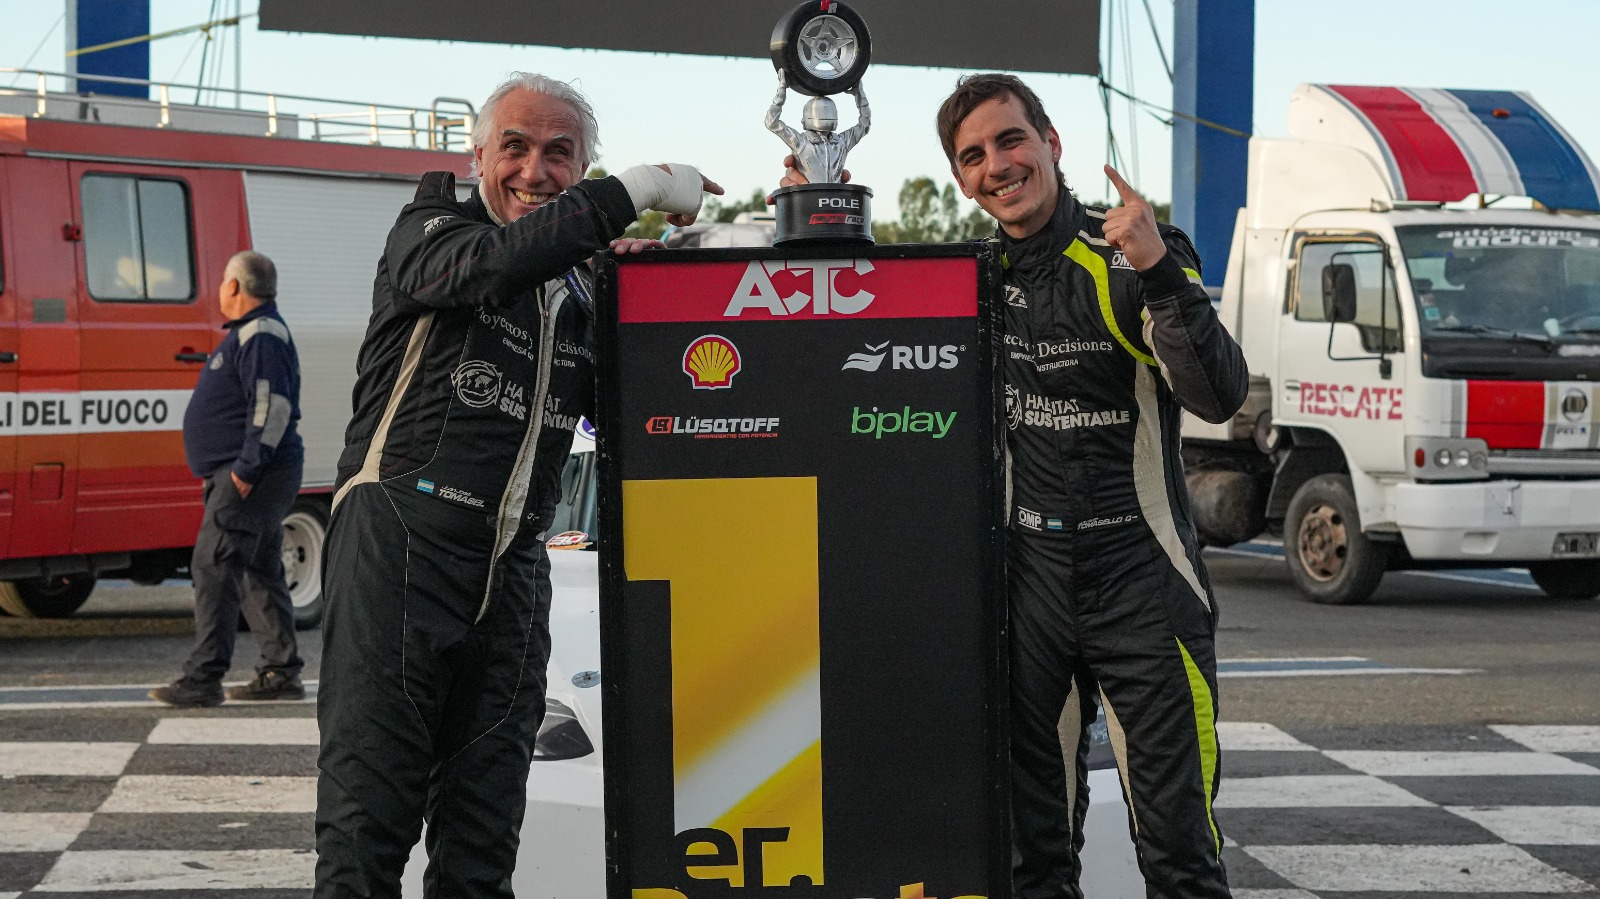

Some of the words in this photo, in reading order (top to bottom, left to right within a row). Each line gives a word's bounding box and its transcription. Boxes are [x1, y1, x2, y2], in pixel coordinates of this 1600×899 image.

[818, 198, 860, 209] POLE
[1111, 253, 1134, 268] OM
[723, 259, 876, 316] ACTC
[1037, 338, 1113, 358] Decisiones
[1299, 382, 1403, 420] RESCATE
[22, 400, 72, 426] DEL
[81, 398, 168, 425] FUOCO
[851, 406, 957, 439] bplay
[1024, 410, 1130, 431] SUSTENTABLE
[1018, 508, 1042, 529] OMP
